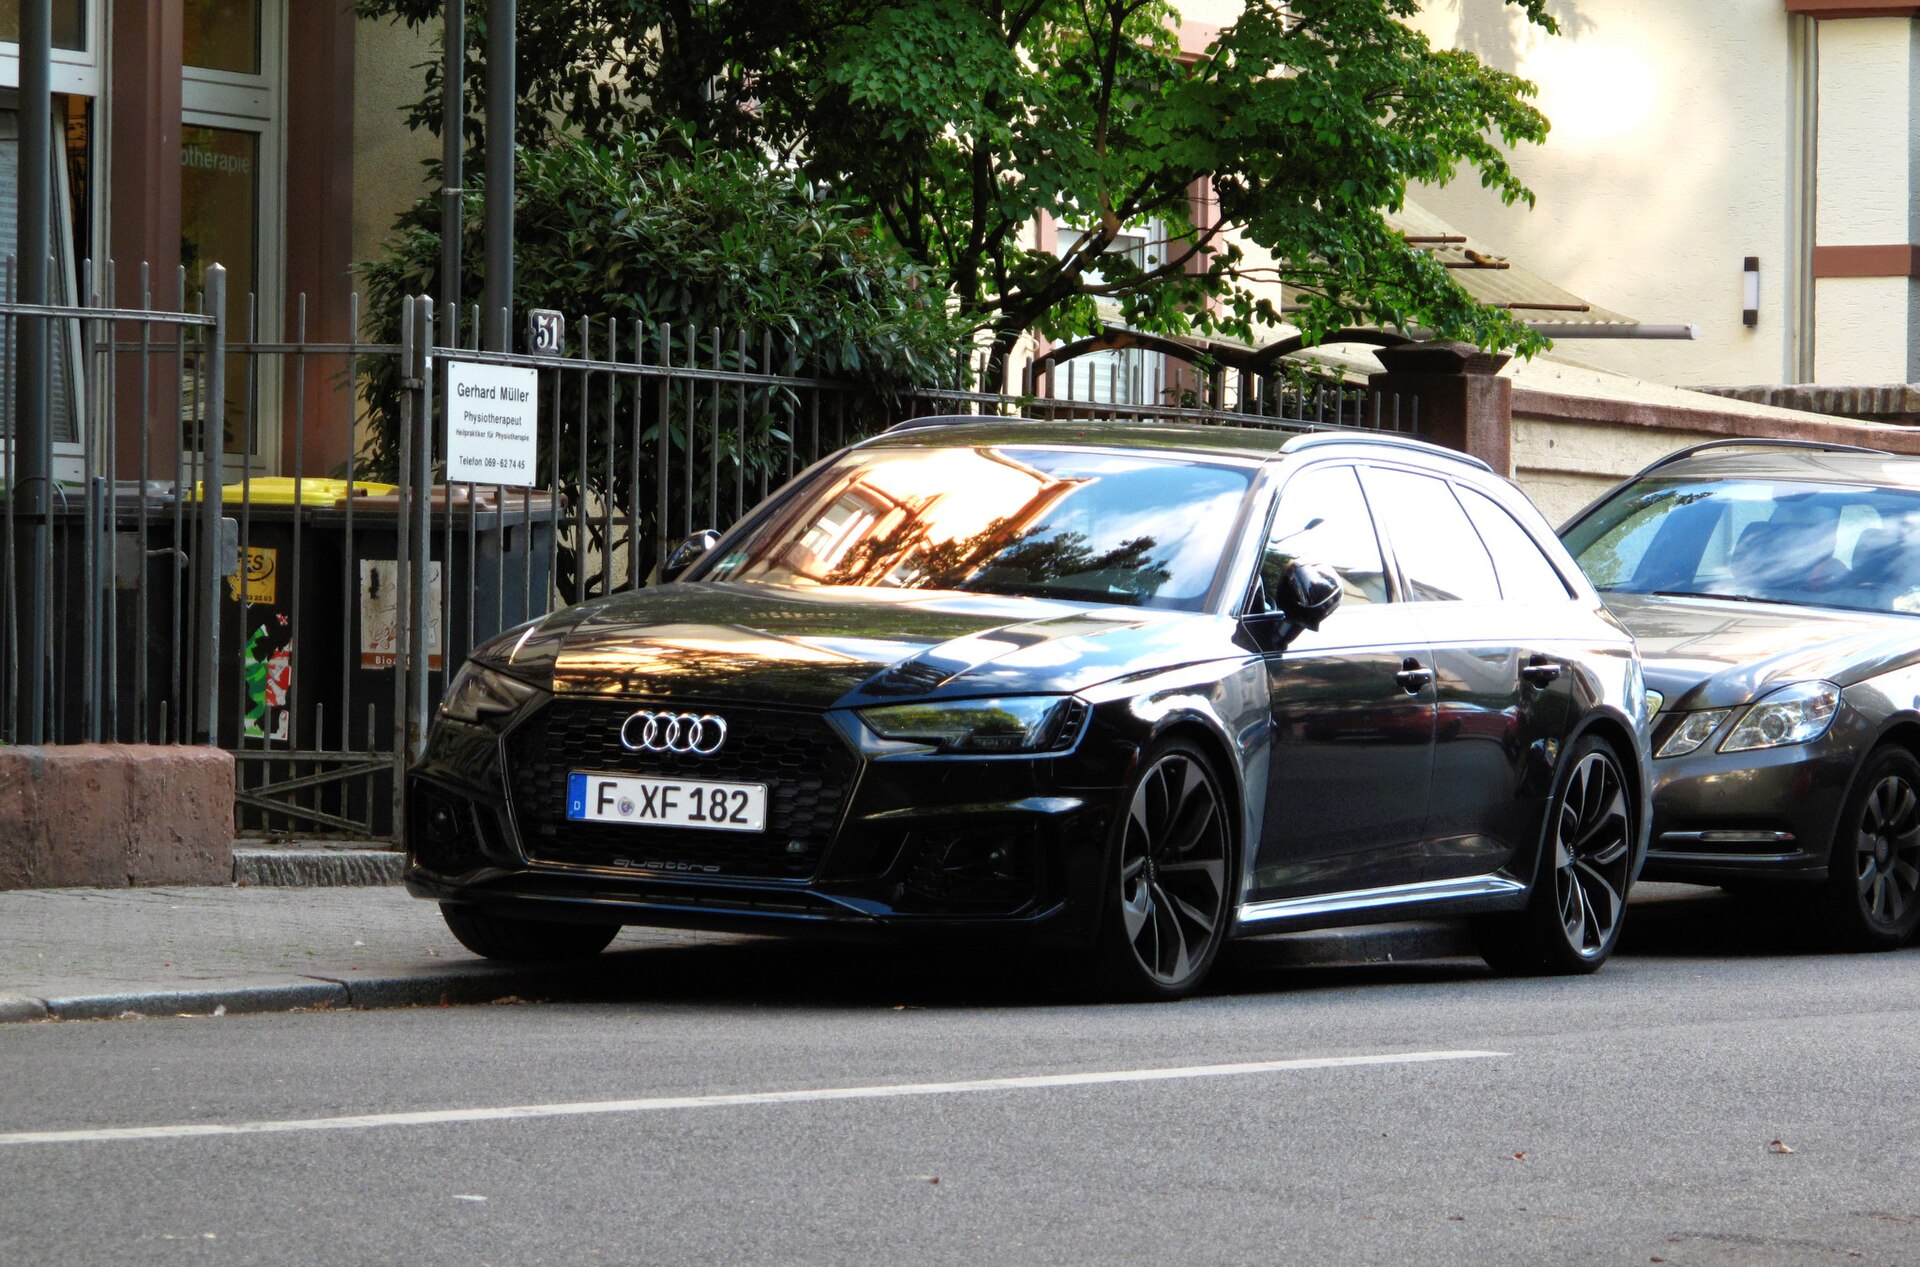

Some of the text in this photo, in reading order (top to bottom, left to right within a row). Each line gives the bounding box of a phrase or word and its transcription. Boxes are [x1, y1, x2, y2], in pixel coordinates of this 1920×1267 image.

[537, 315, 558, 350] 51
[457, 382, 530, 403] Gerhard Müller
[463, 410, 522, 427] Physiotherapeut
[495, 431, 530, 443] Physiotherapie
[459, 455, 483, 466] Telefon
[573, 800, 581, 811] D
[597, 781, 749, 824] F XF 182
[613, 858, 721, 872] quattro
